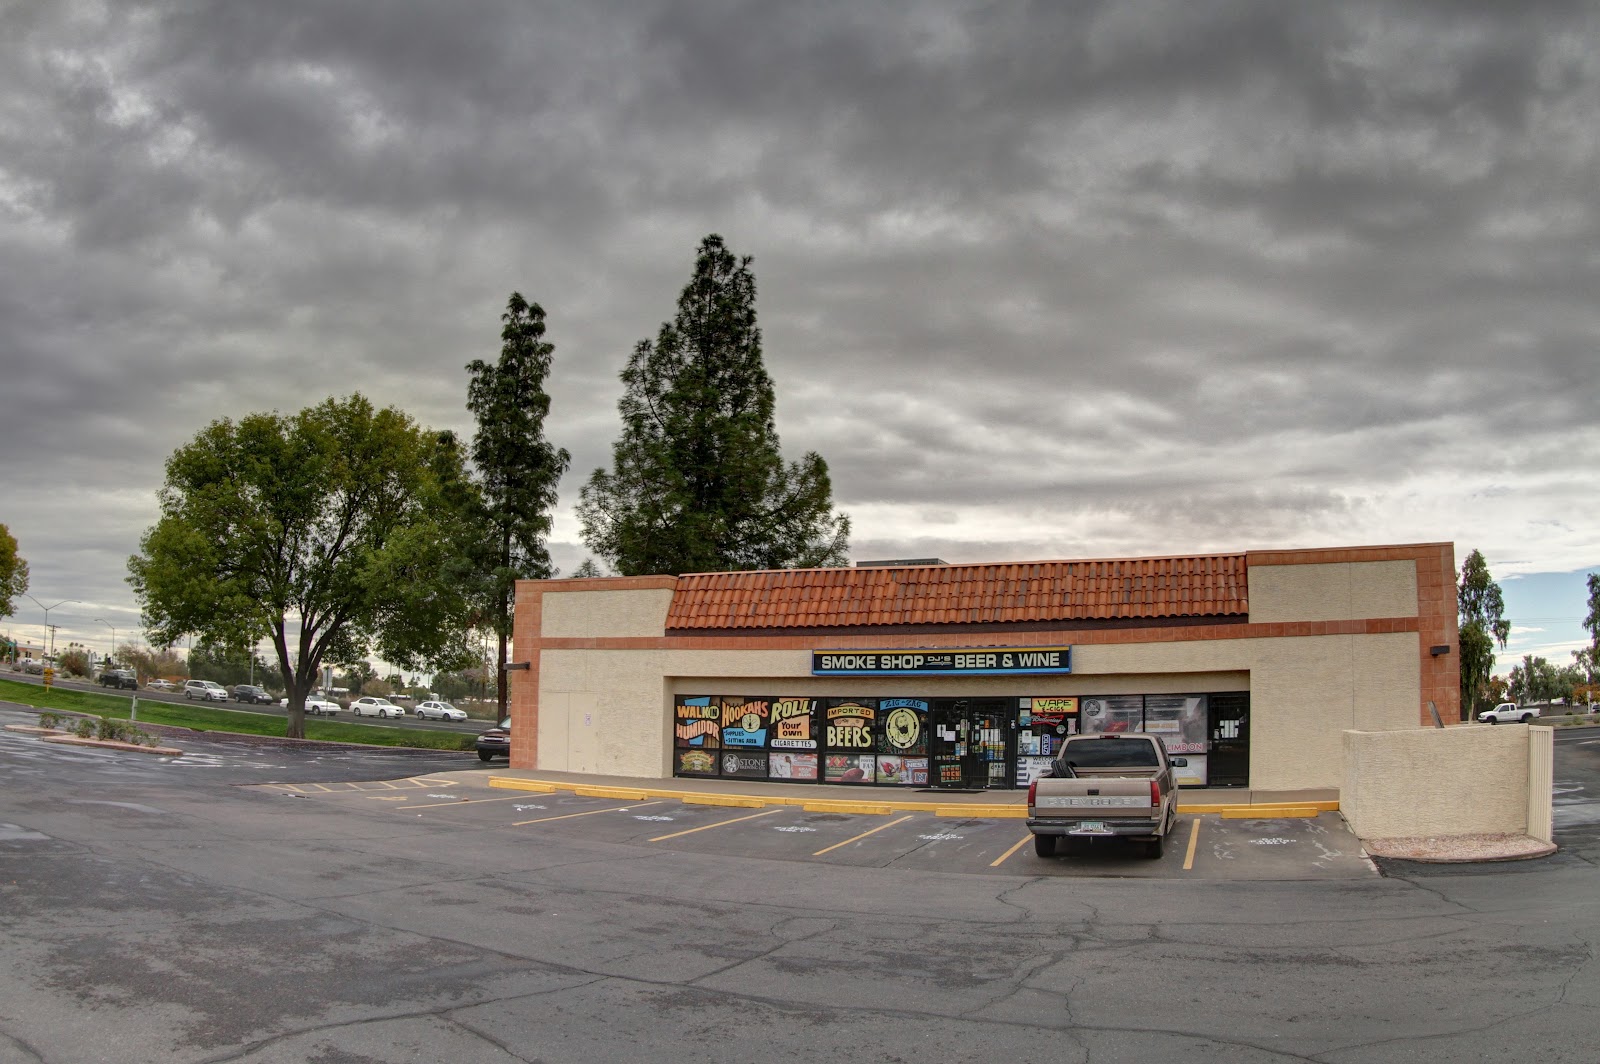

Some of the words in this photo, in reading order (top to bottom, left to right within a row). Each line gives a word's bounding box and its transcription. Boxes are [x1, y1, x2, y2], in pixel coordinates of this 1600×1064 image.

[821, 655, 876, 669] SMOKE
[880, 655, 924, 669] SHOP
[954, 654, 997, 668] BEER
[1002, 653, 1014, 668] &
[1018, 652, 1060, 667] WINE
[1037, 699, 1072, 707] VAPE
[721, 700, 769, 728] HOOKAHS
[770, 700, 818, 724] ROLL!
[828, 708, 872, 717] IMPORTED
[676, 720, 720, 742] HUMIDOR
[781, 721, 802, 730] Your
[774, 740, 812, 748] CIGARETTES
[826, 726, 872, 748] BEERS
[739, 758, 766, 767] STONE
